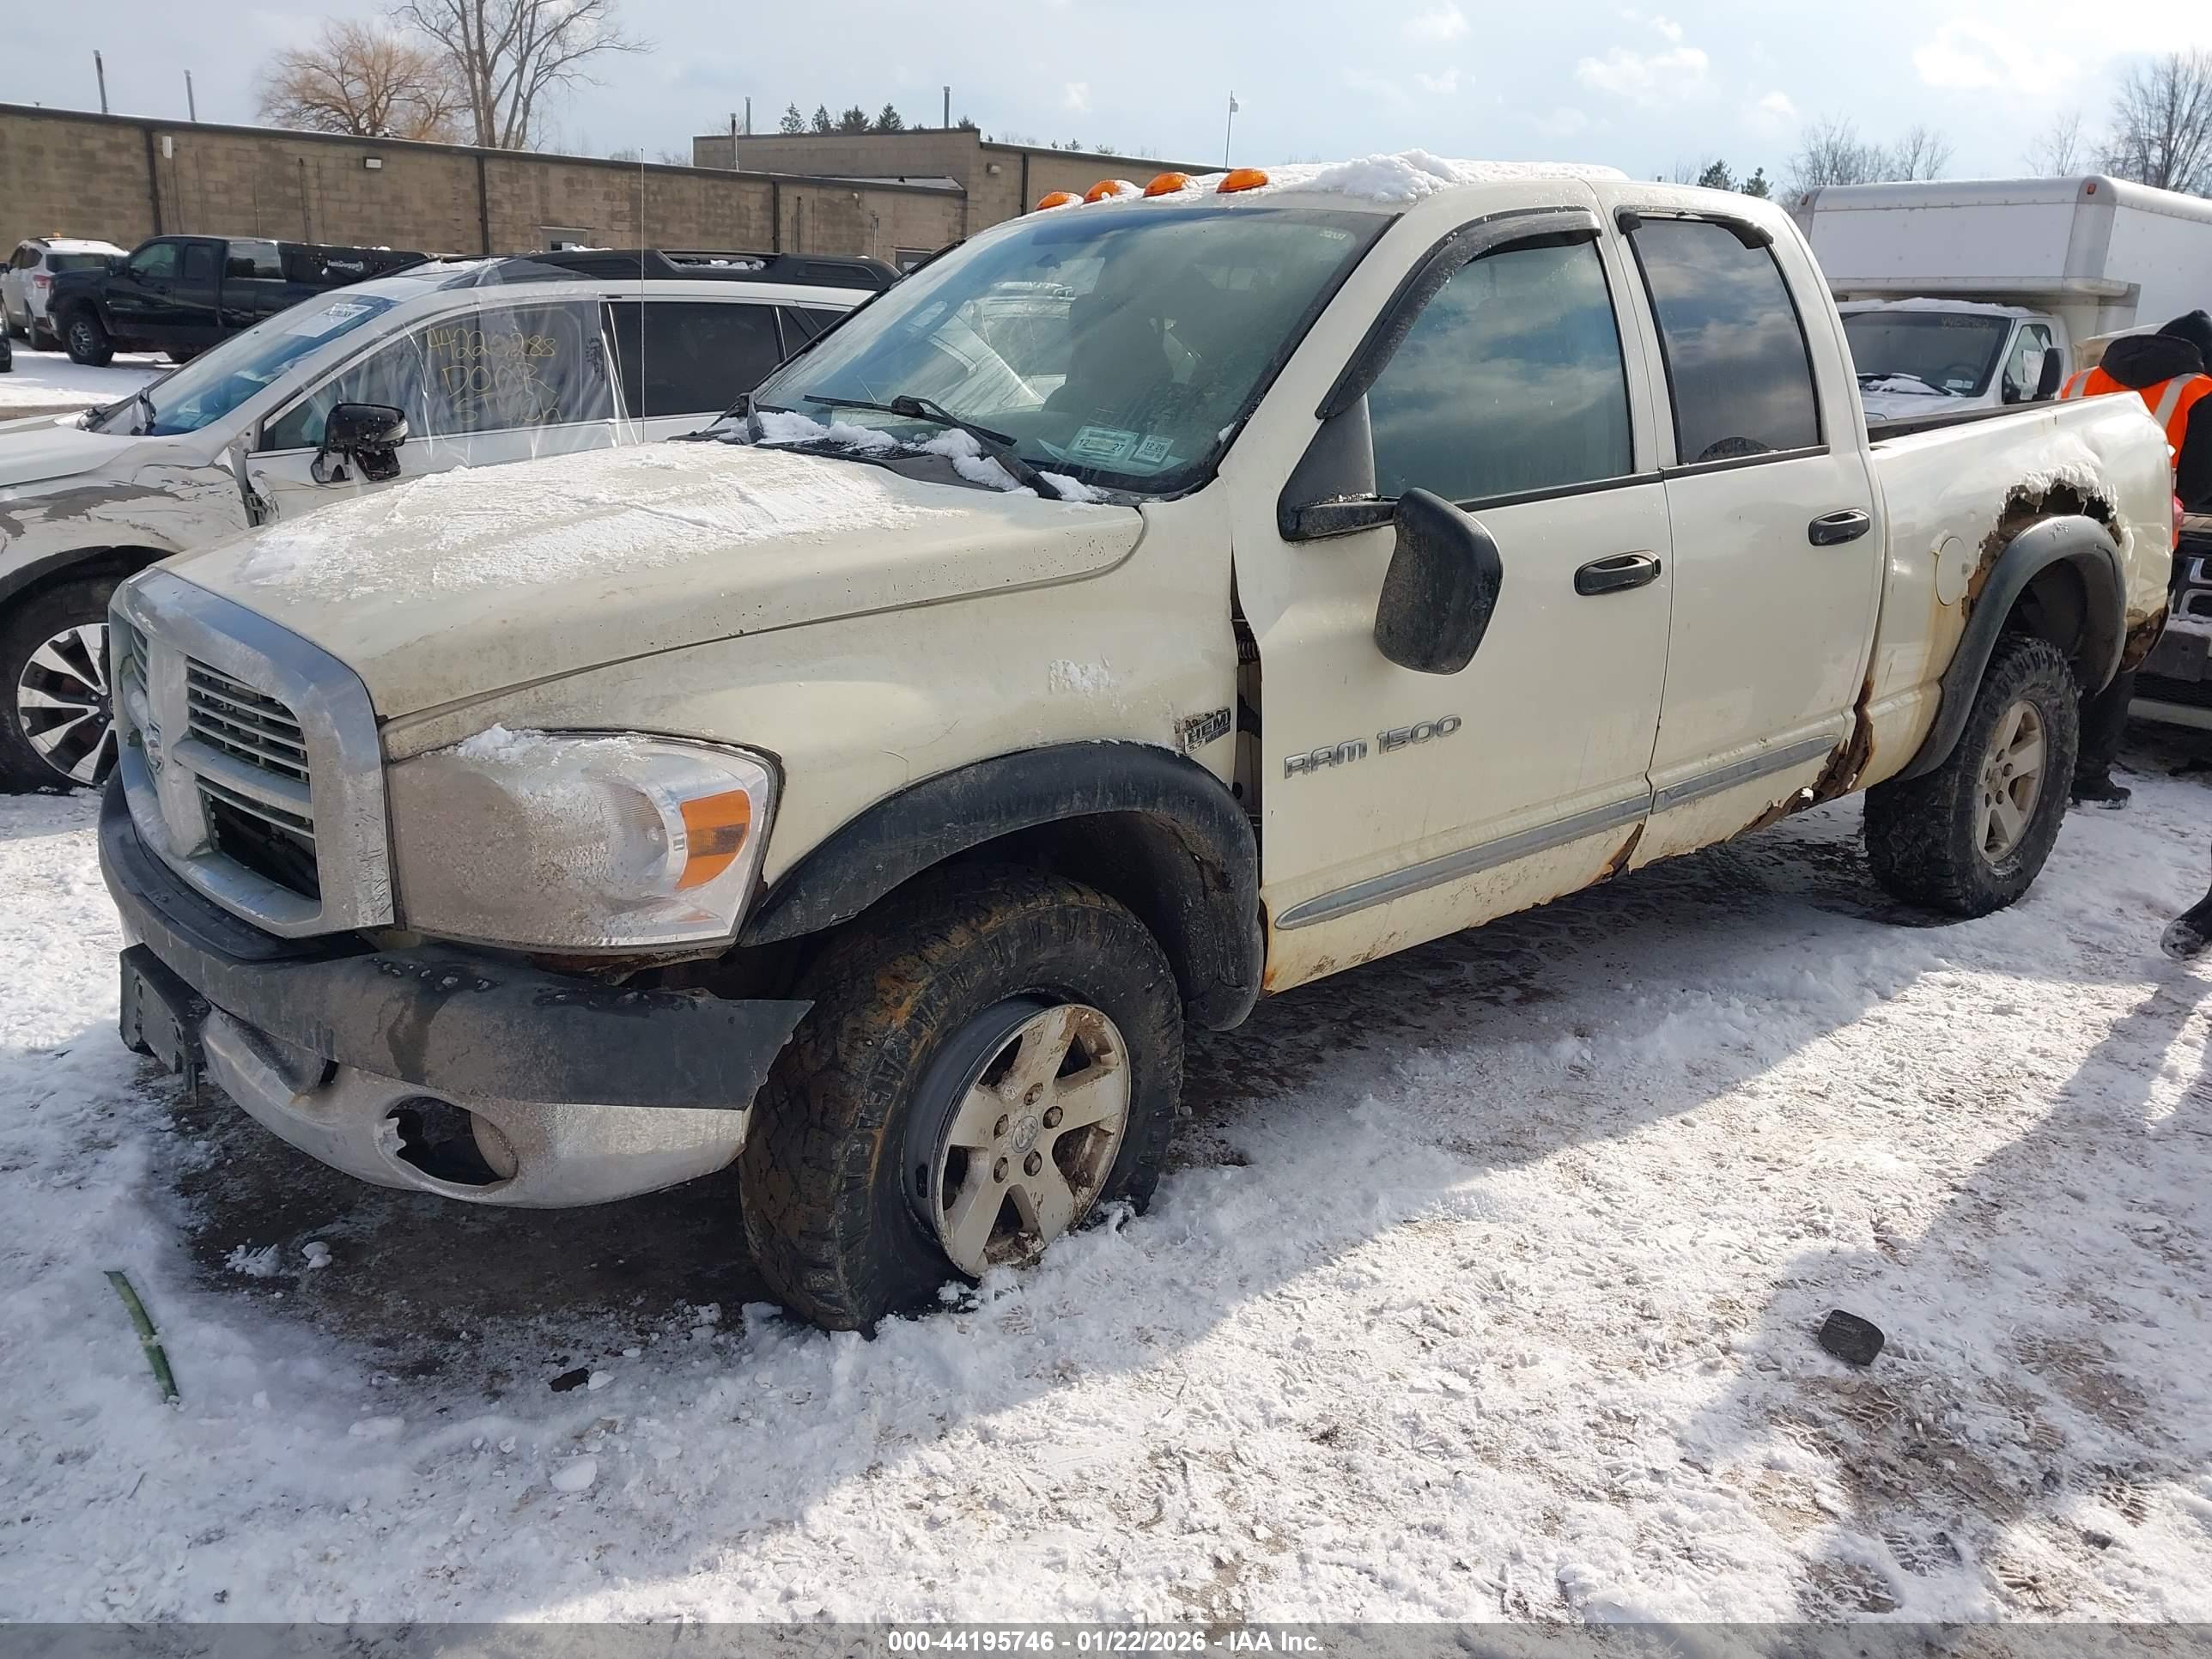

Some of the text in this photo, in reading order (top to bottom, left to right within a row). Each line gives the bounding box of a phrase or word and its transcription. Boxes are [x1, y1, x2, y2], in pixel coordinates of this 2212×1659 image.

[441, 362, 557, 398] DOOR
[1112, 443, 1125, 452] 27
[1146, 441, 1155, 450] 12
[1188, 710, 1231, 744] HEMI
[1188, 740, 1202, 752] 5.7
[1285, 714, 1462, 779] RAM 1500
